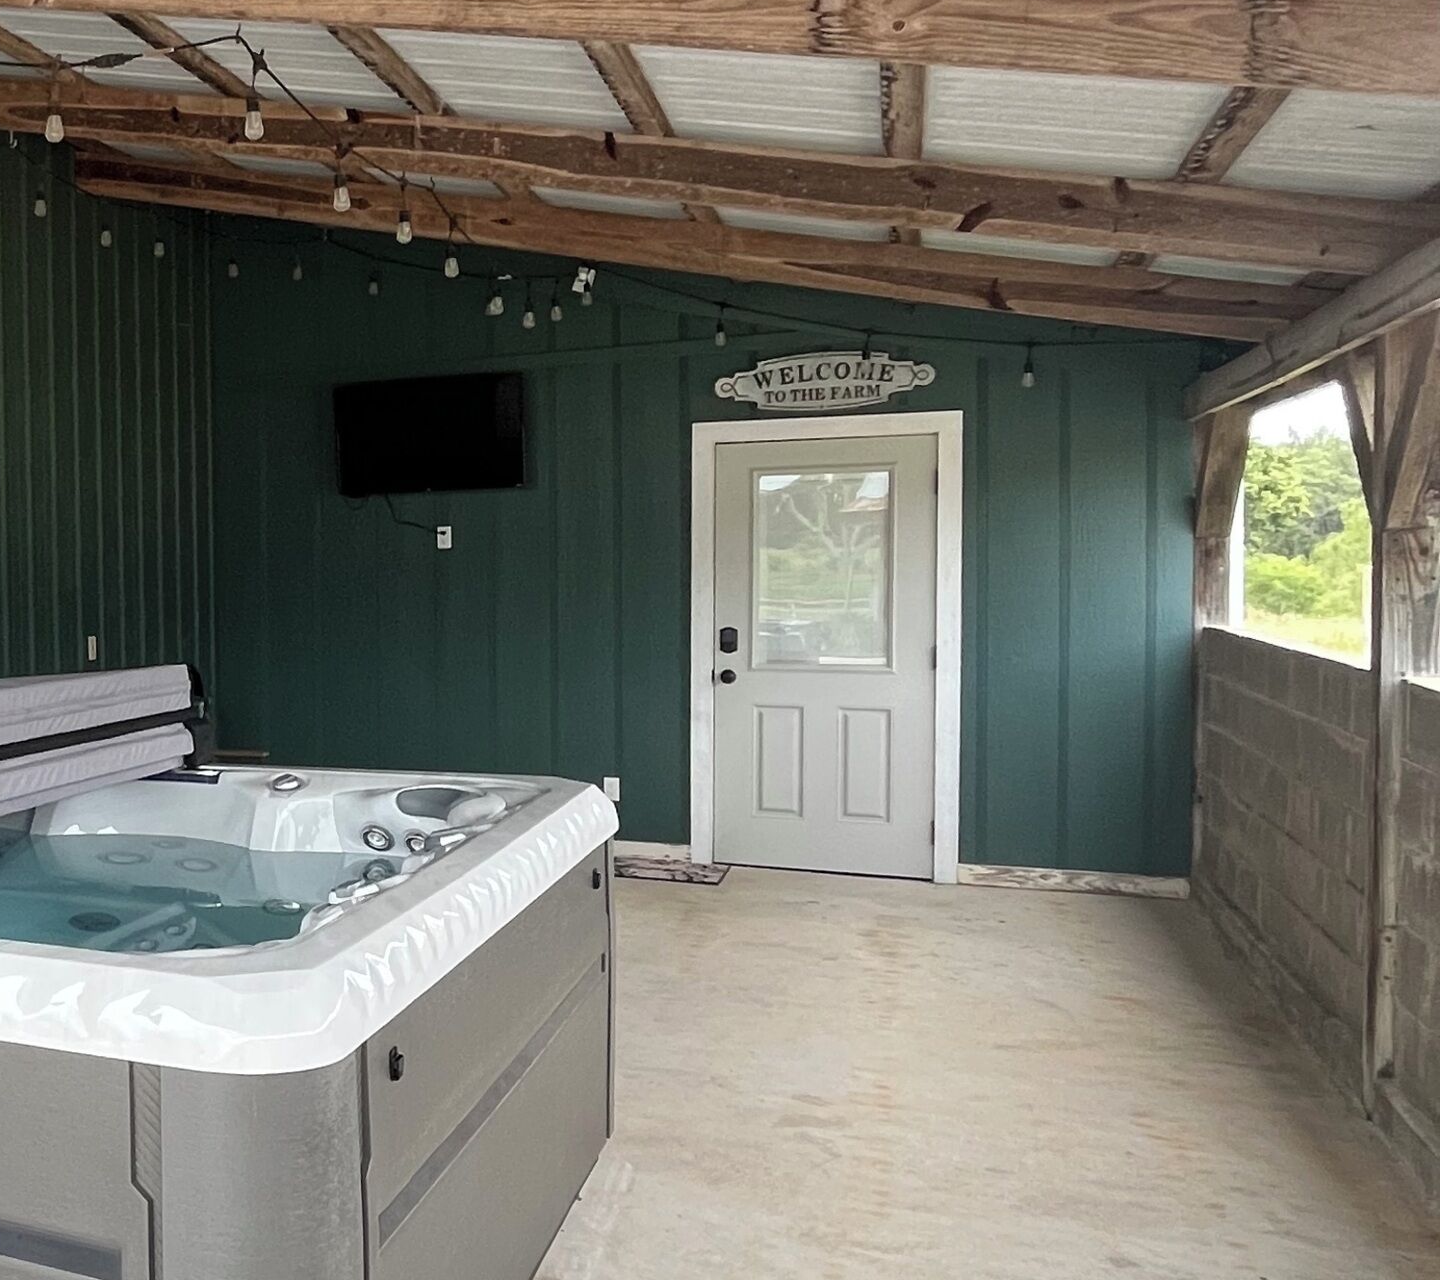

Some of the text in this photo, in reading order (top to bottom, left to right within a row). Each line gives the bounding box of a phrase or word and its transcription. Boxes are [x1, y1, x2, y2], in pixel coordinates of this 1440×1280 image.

[753, 361, 895, 389] WELCOME
[764, 384, 881, 404] TO THE FARM
